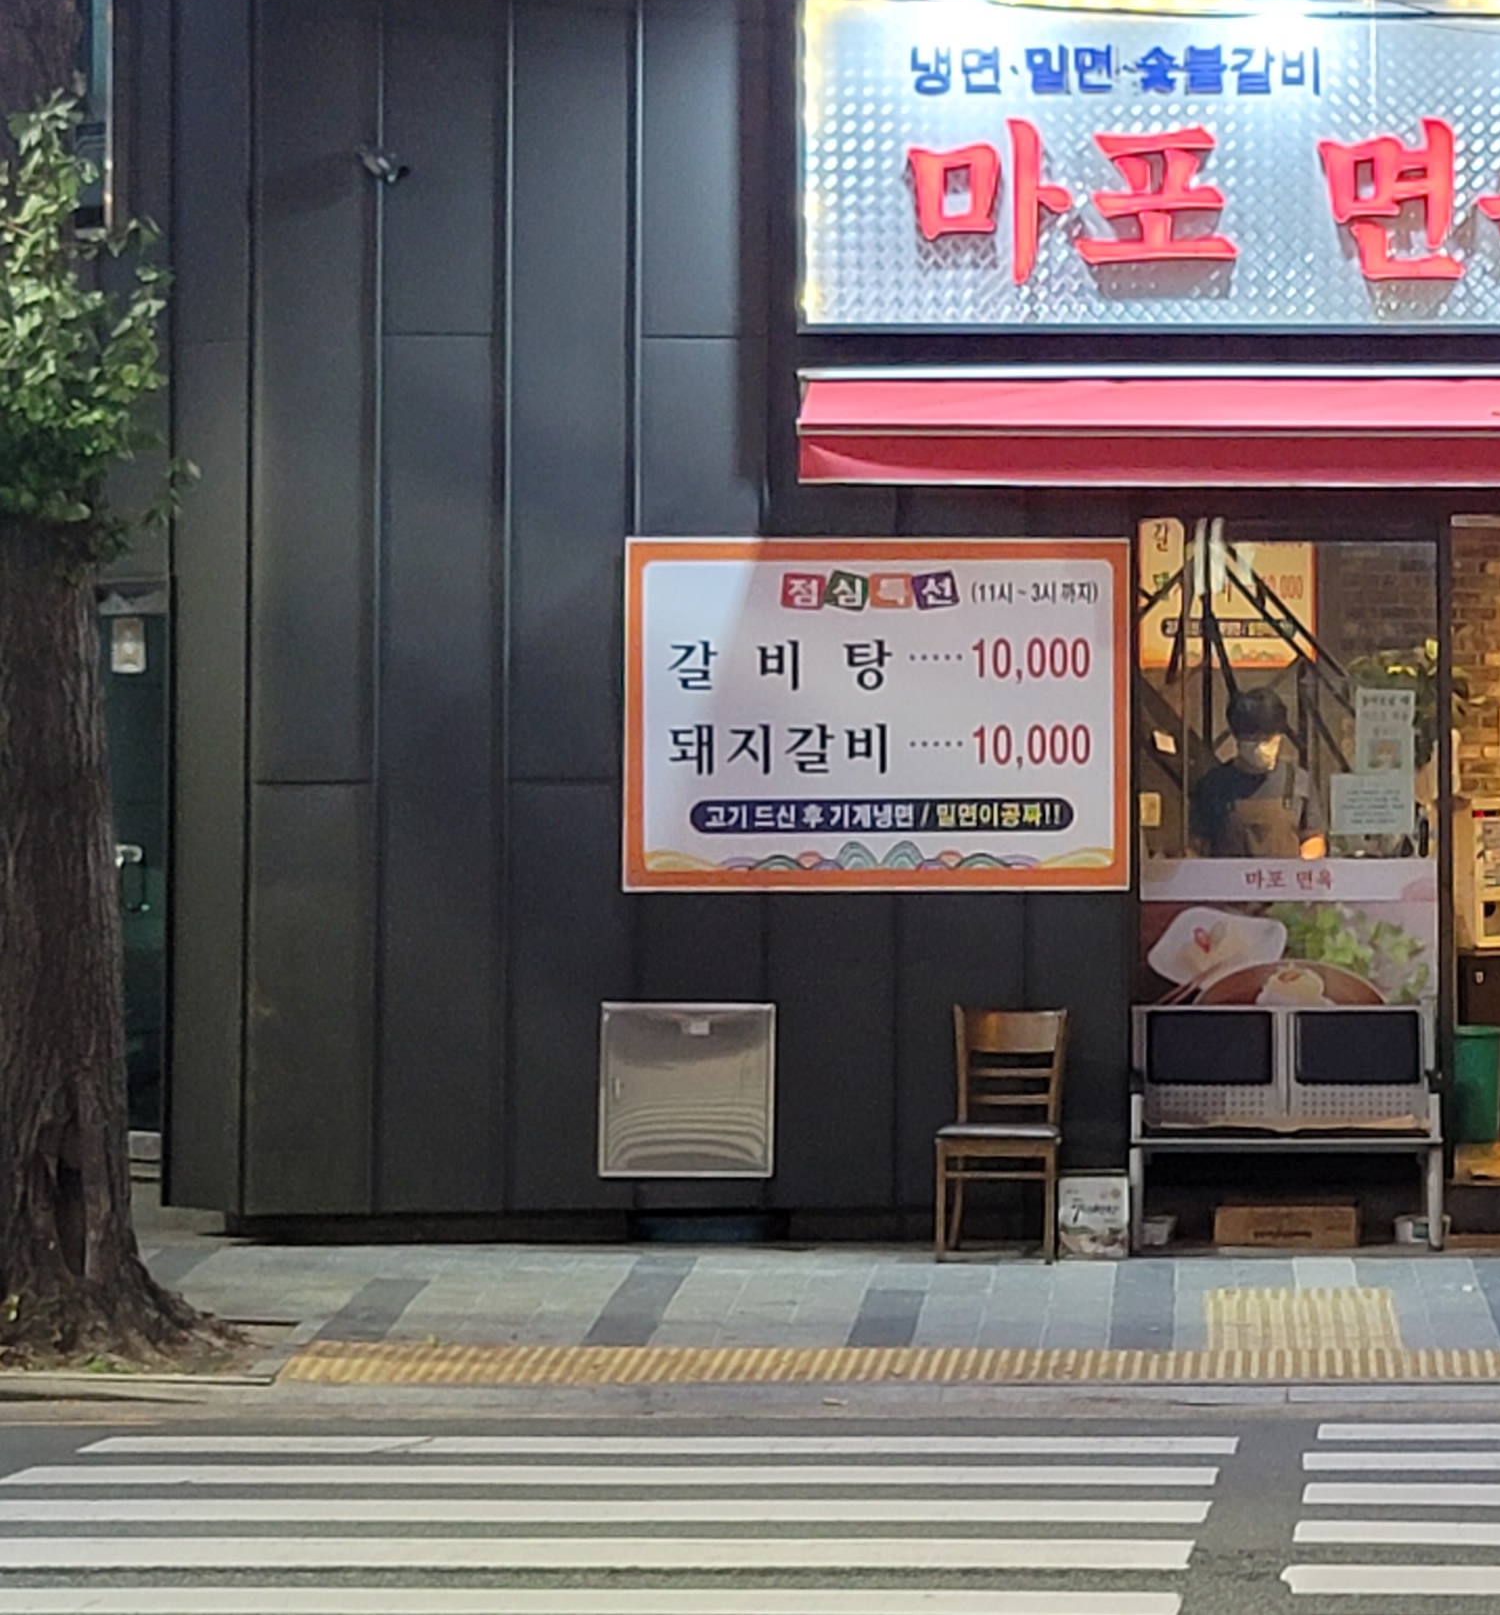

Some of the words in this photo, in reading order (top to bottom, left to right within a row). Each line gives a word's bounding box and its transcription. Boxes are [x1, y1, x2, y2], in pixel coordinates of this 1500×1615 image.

[907, 118, 1238, 285] 마포
[971, 638, 1091, 684] 10,000
[668, 722, 888, 776] 돼지갈비
[971, 724, 1091, 770] 10,000
[1245, 870, 1286, 890] 마포
